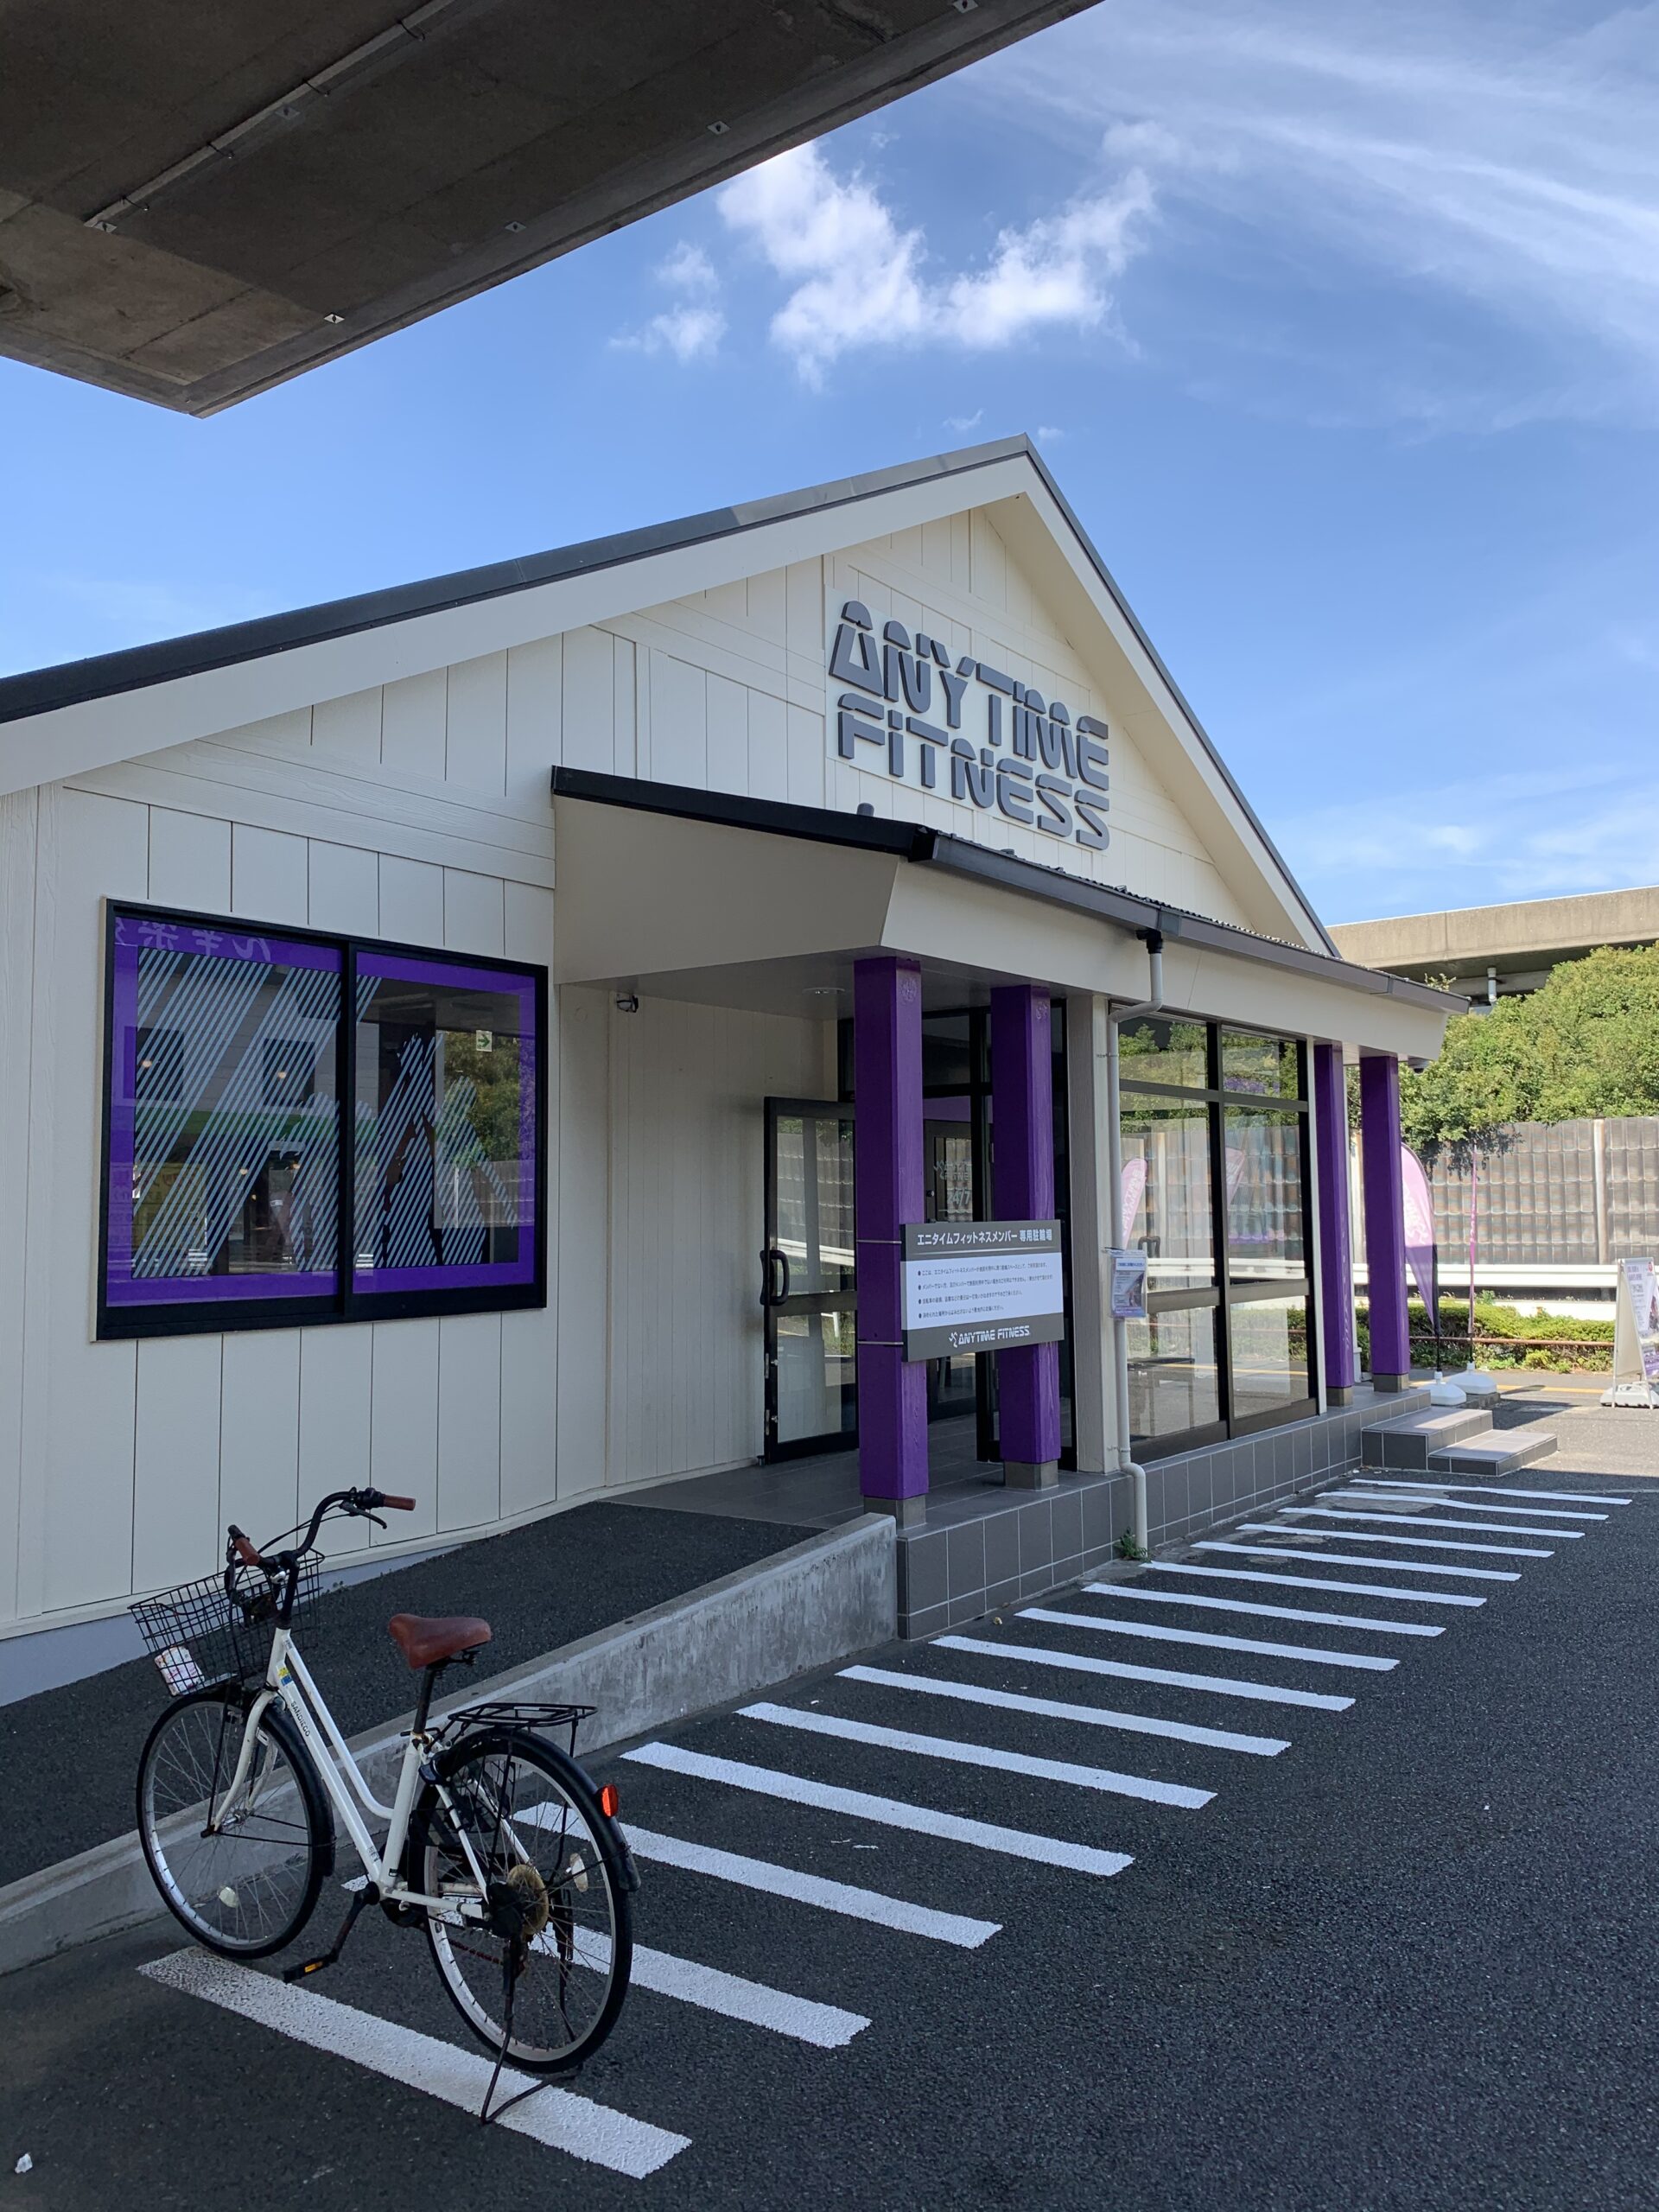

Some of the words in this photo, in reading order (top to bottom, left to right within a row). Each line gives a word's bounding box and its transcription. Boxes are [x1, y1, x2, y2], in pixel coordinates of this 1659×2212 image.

[829, 600, 1109, 791] ANYTIME
[837, 692, 1110, 851] FITNESS
[917, 1230, 1018, 1246] エニタイムフィットネスメンバー
[957, 1329, 995, 1345] ANYTIME
[997, 1325, 1030, 1340] FITNESS
